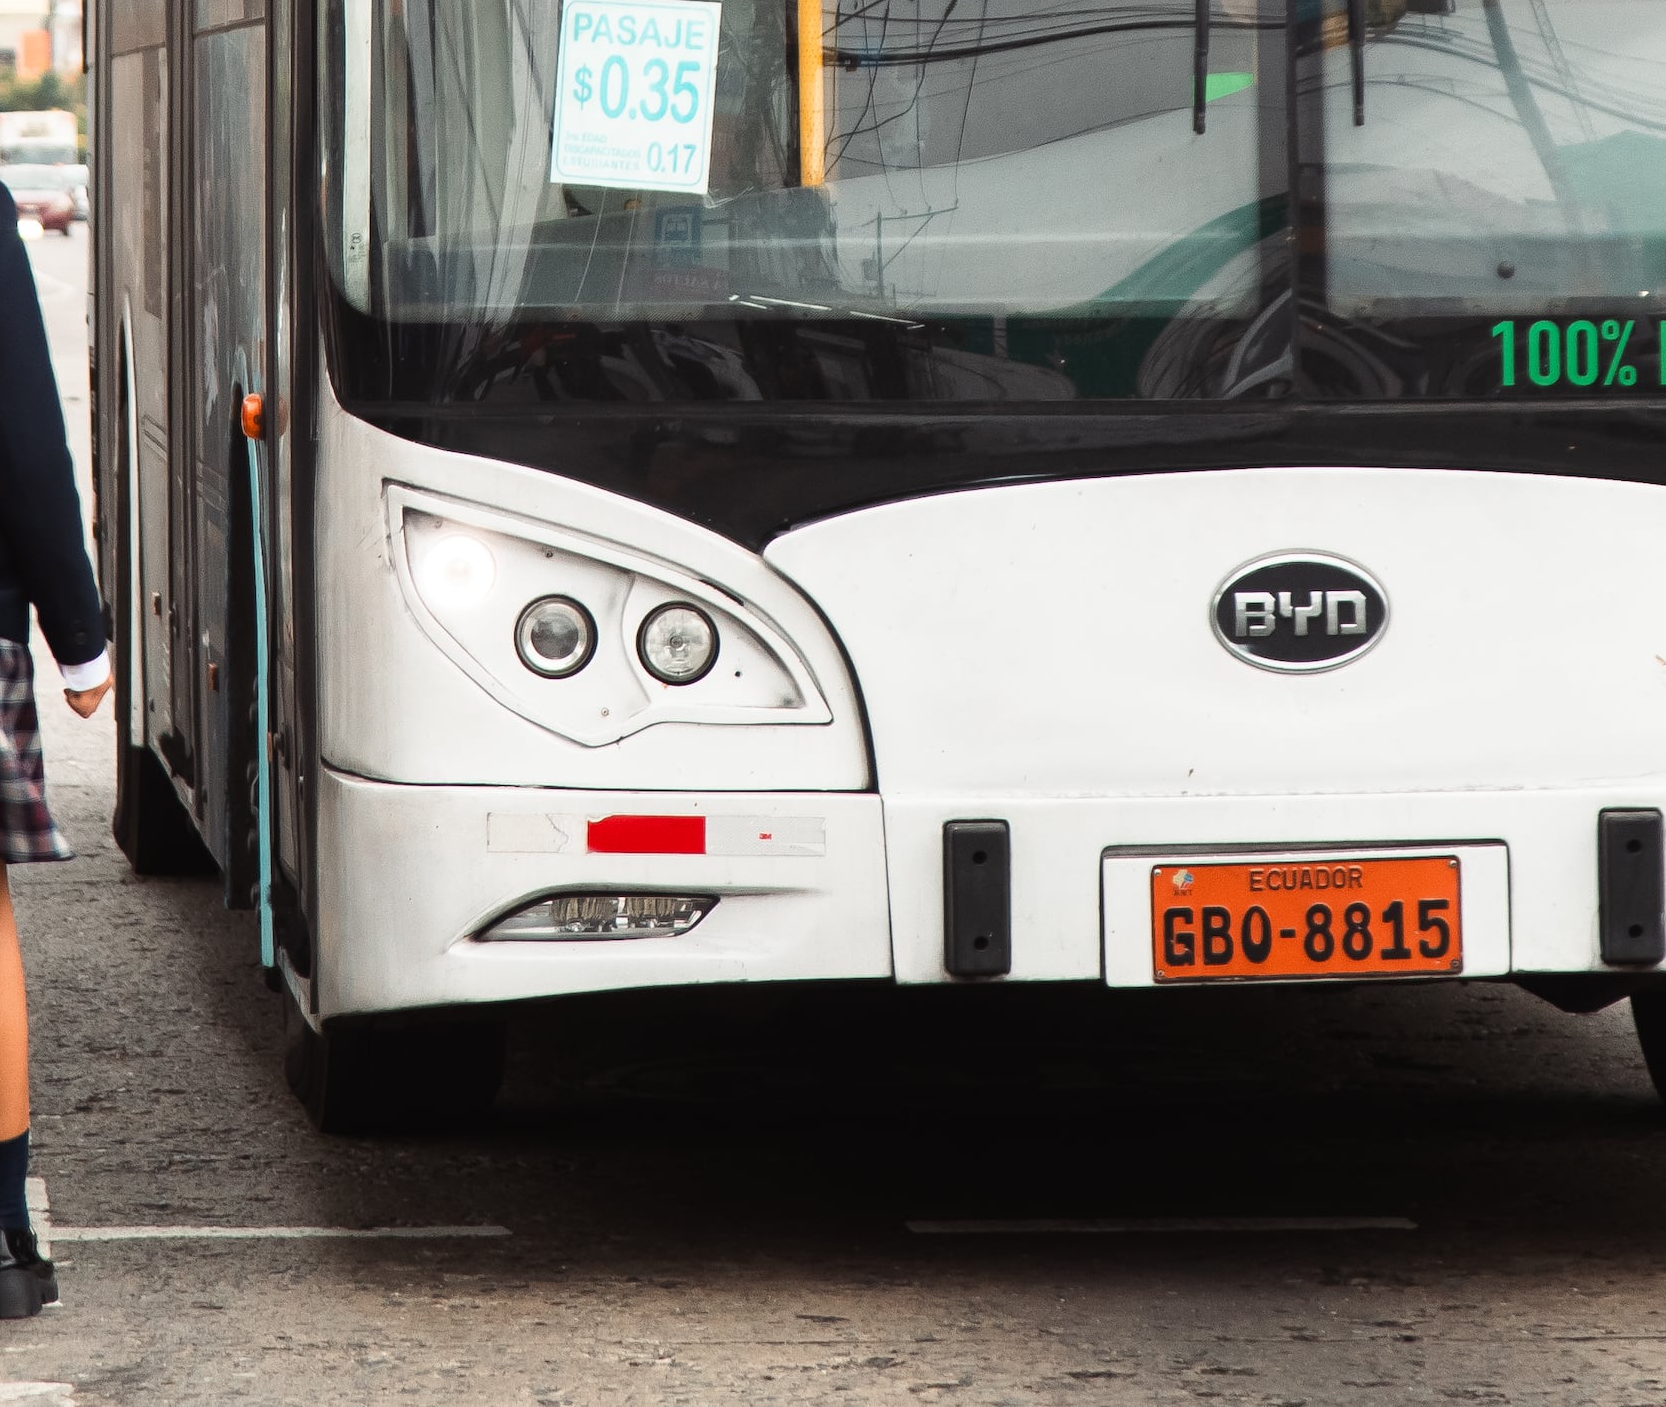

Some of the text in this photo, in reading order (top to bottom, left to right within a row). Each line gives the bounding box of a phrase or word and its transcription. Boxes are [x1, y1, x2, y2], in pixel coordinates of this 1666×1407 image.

[573, 12, 704, 52] PASAJE
[647, 141, 697, 175] 0.17
[1490, 318, 1638, 387] 100%
[1234, 590, 1367, 636] BYD
[1248, 866, 1364, 893] ECUADOR
[1162, 898, 1451, 968] GBO-8815
